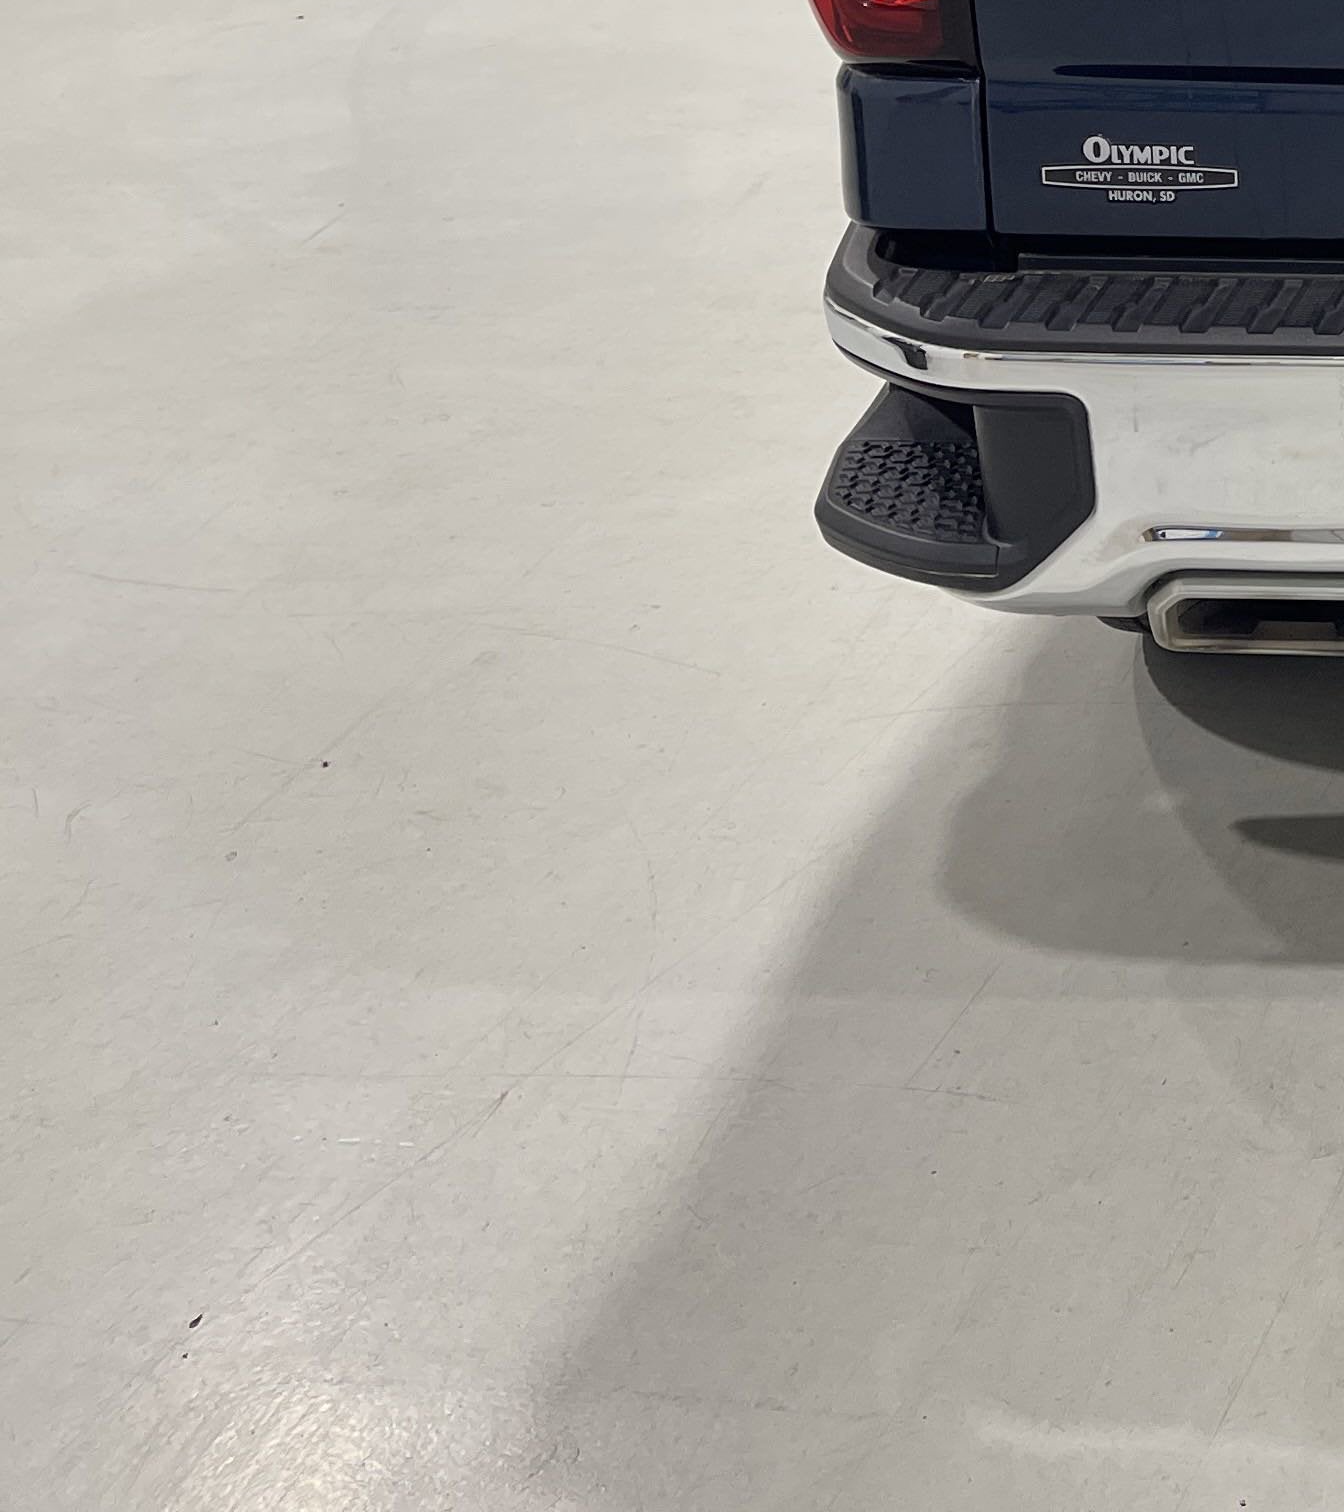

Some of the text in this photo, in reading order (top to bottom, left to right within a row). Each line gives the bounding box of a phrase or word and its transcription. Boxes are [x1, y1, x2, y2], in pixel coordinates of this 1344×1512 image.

[1075, 171, 1112, 183] CHEVY
[1128, 172, 1162, 183] BUICK
[1178, 172, 1204, 183] GMC
[1108, 191, 1175, 203] HURON, SD
